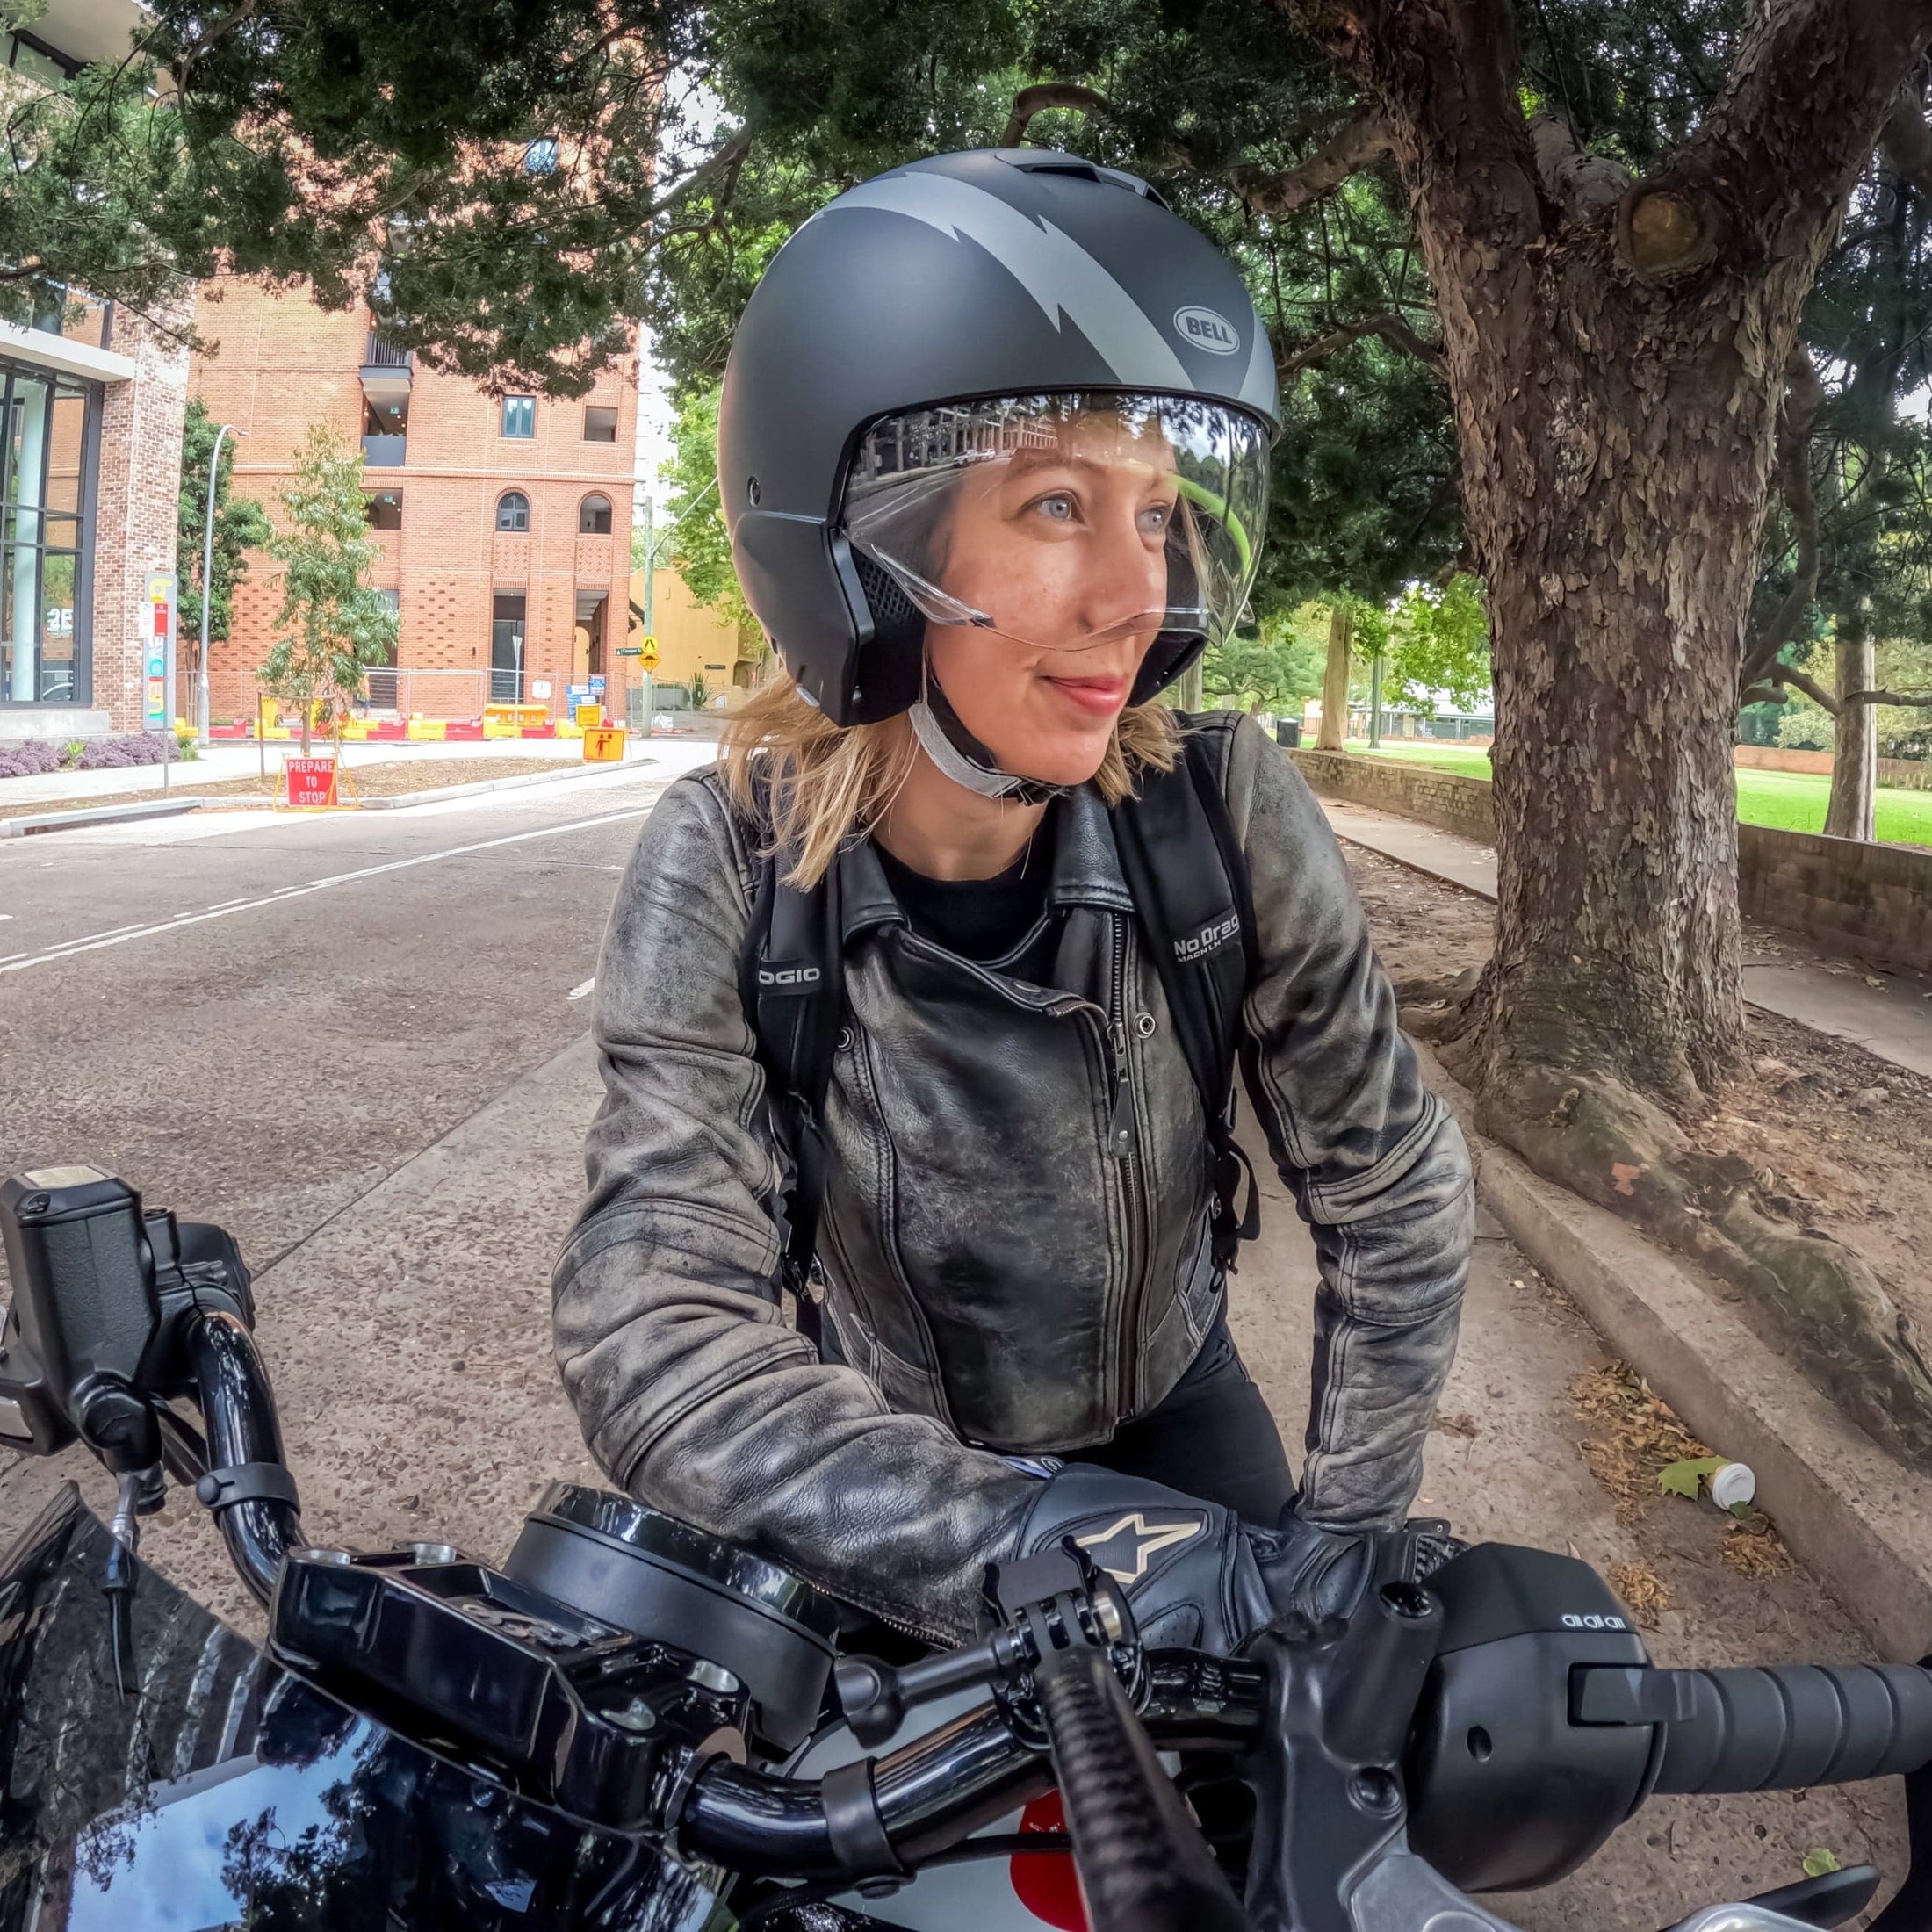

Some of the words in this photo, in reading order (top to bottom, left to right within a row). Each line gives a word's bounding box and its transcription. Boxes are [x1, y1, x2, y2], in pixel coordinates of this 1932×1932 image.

[1186, 316, 1233, 345] BELL
[288, 761, 334, 774] PREPARE
[305, 775, 318, 789] TO
[299, 790, 327, 804] STOP
[1173, 938, 1200, 956] No
[1200, 913, 1240, 947] Drag
[1177, 947, 1208, 963] MACH
[758, 967, 821, 985] OGIO
